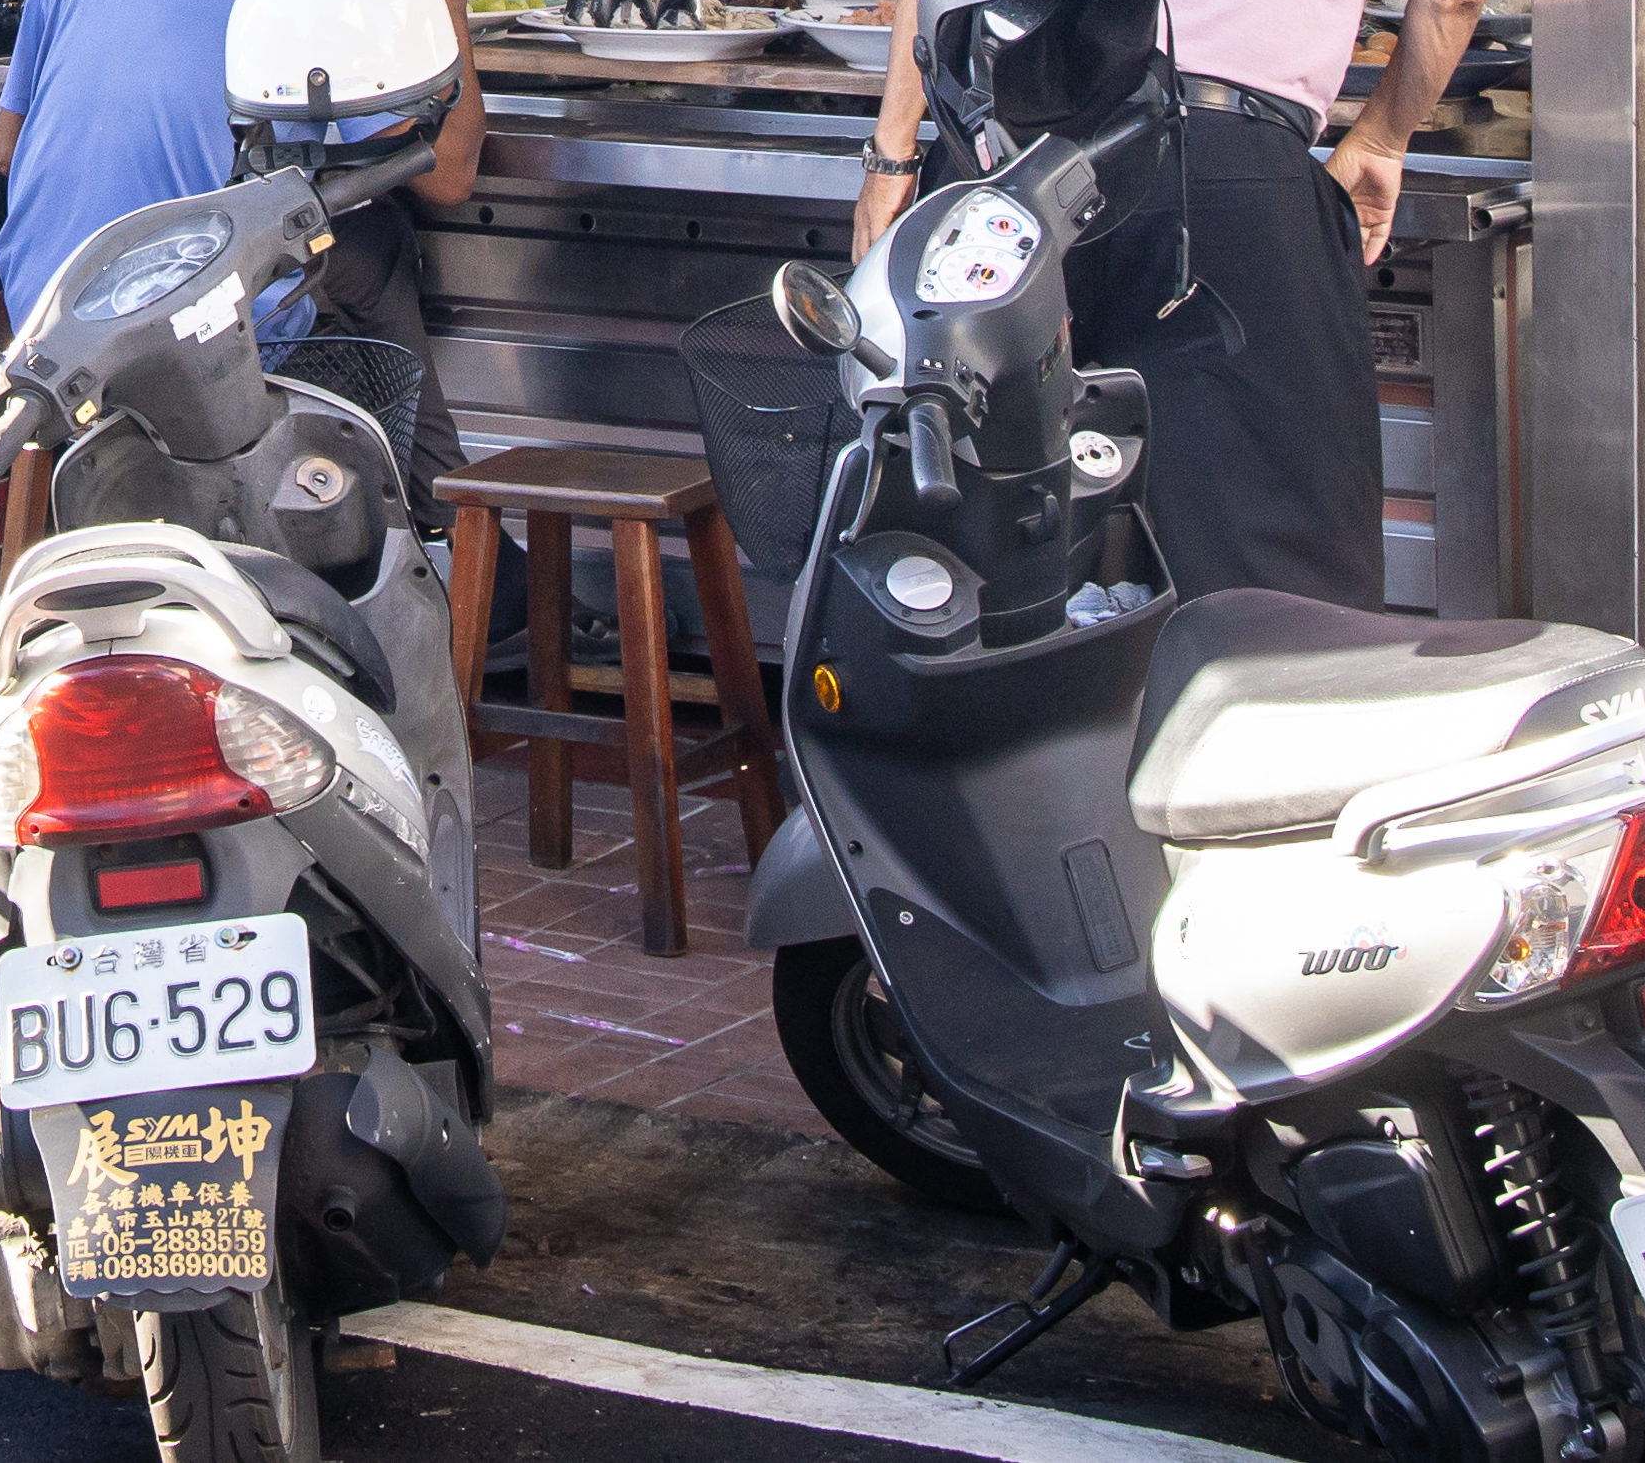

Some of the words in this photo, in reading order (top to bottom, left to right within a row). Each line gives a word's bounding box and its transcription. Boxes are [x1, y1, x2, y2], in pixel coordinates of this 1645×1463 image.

[90, 933, 209, 976] 台灣省
[7, 970, 304, 1086] BU6-529
[66, 1109, 140, 1191] 展
[200, 1099, 272, 1181] 坤
[123, 1113, 198, 1143] SYM
[127, 1144, 198, 1164] 三陽機車
[79, 1180, 254, 1216] 各種機車保養
[66, 1206, 267, 1239] 嘉義市玉山路27號
